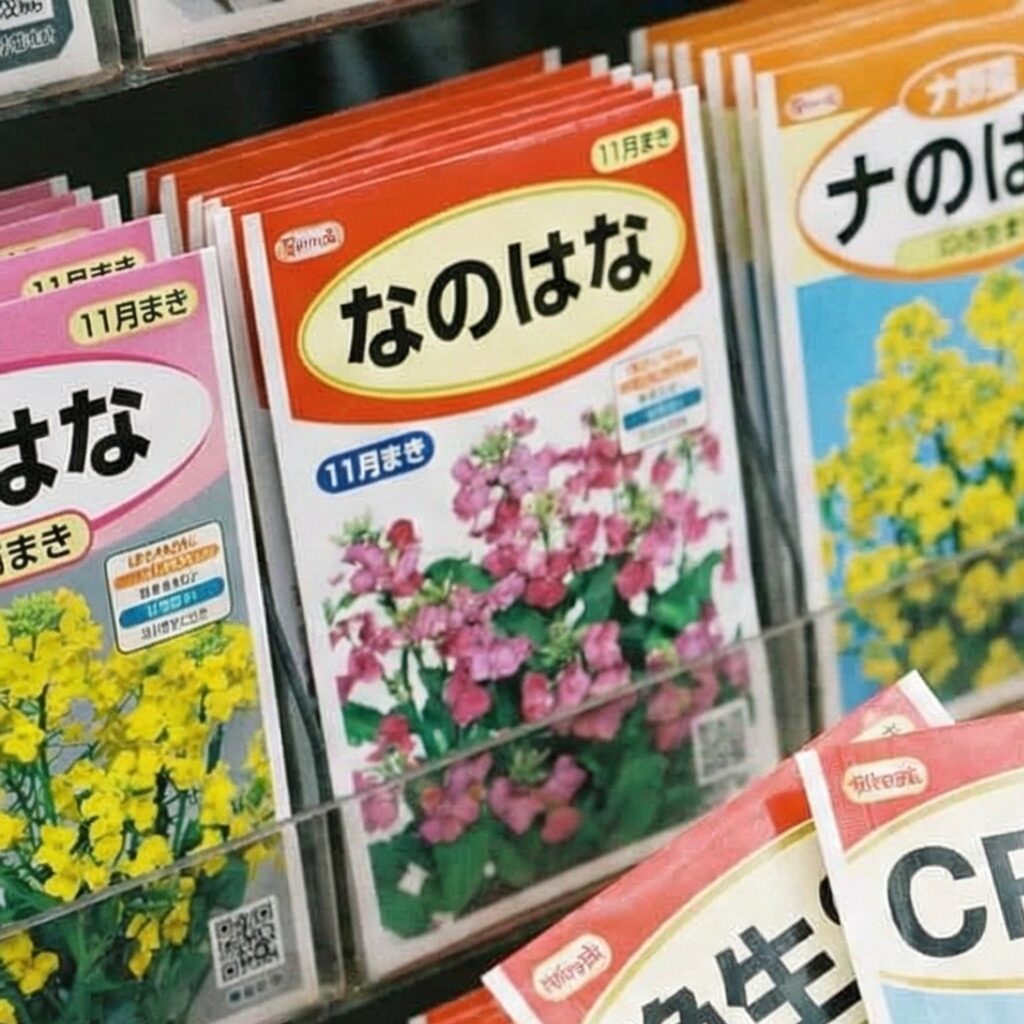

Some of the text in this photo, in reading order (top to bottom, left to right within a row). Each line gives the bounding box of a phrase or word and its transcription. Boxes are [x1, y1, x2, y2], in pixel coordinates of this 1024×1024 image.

[597, 126, 669, 167] 11月まき
[80, 288, 188, 338] 11月まき
[340, 213, 652, 367] なのはな
[324, 437, 425, 487] 11月まき
[0, 524, 71, 576] まき
